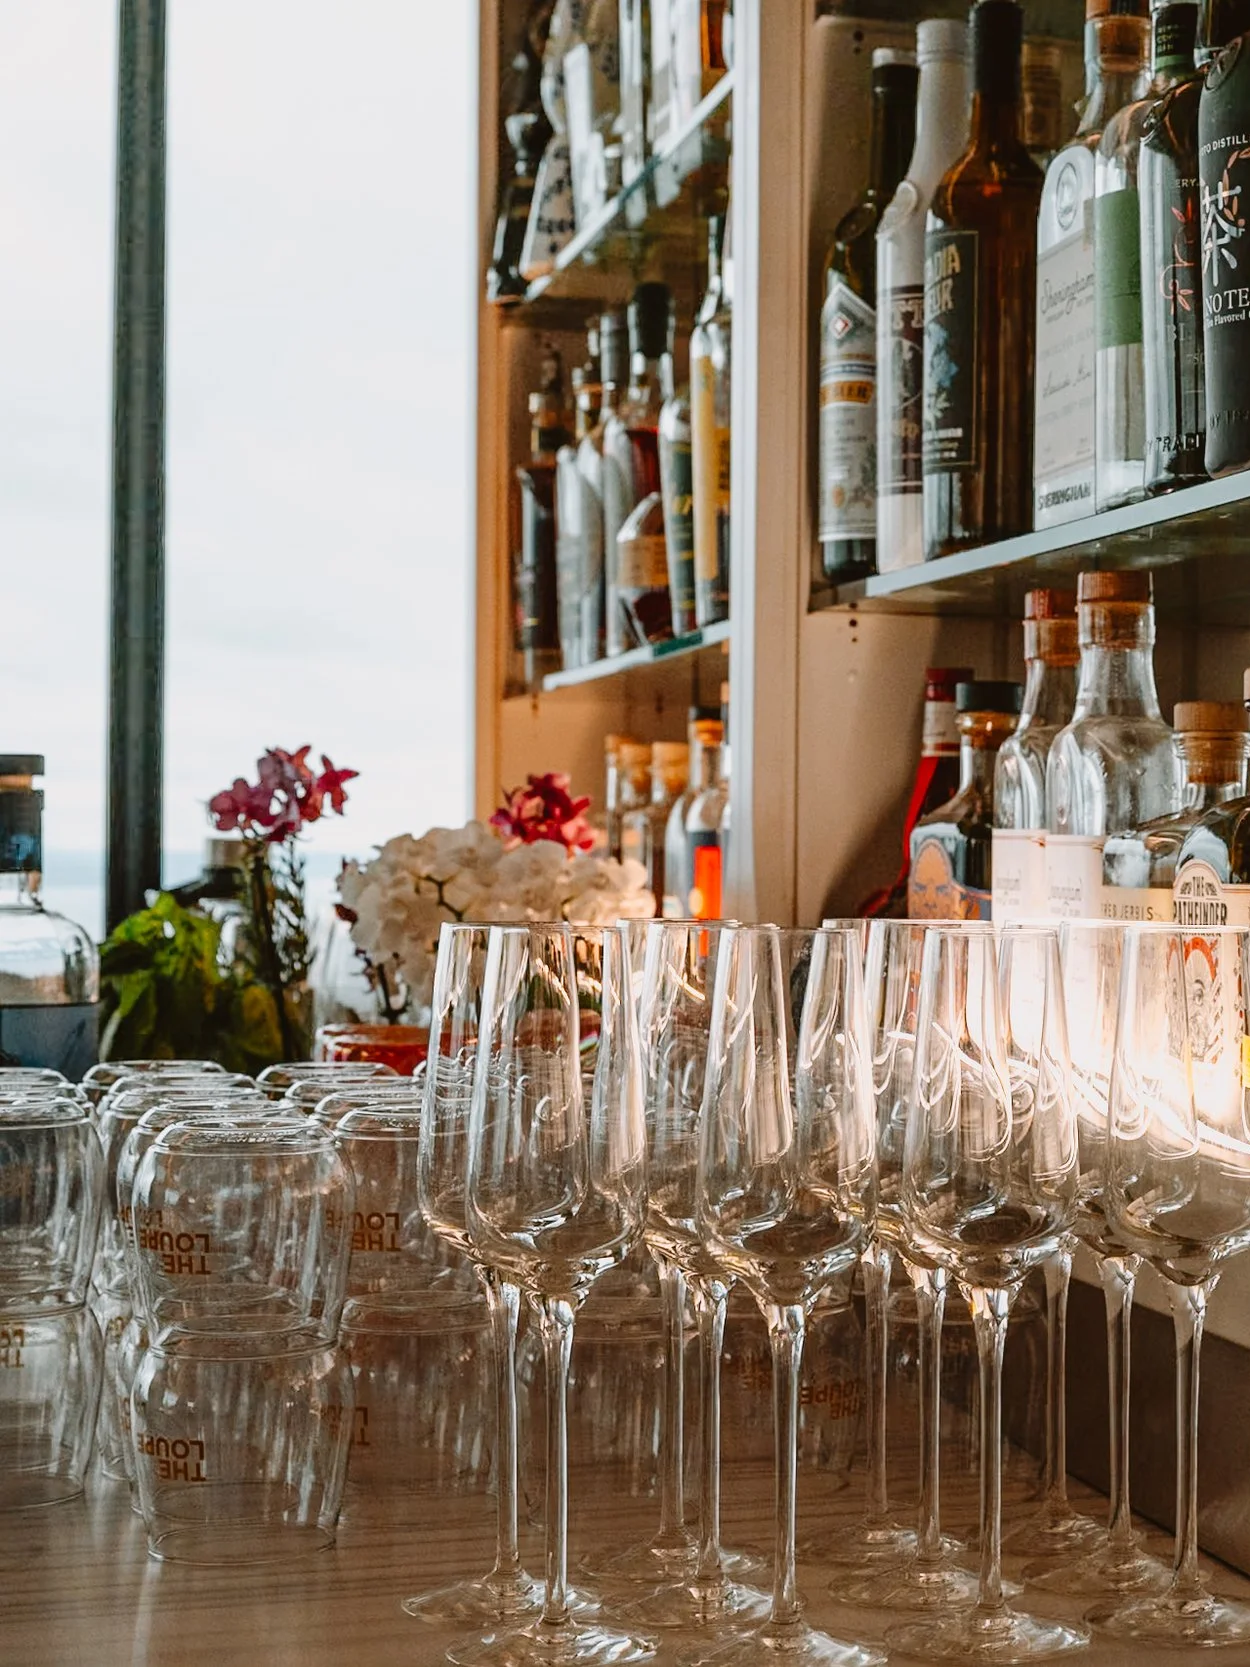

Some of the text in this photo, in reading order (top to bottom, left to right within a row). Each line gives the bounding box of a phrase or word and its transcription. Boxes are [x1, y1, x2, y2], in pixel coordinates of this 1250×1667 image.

[1214, 309, 1246, 326] Flavored
[1192, 876, 1205, 897] THE
[162, 1254, 212, 1275] THE
[158, 1460, 207, 1482] THE
